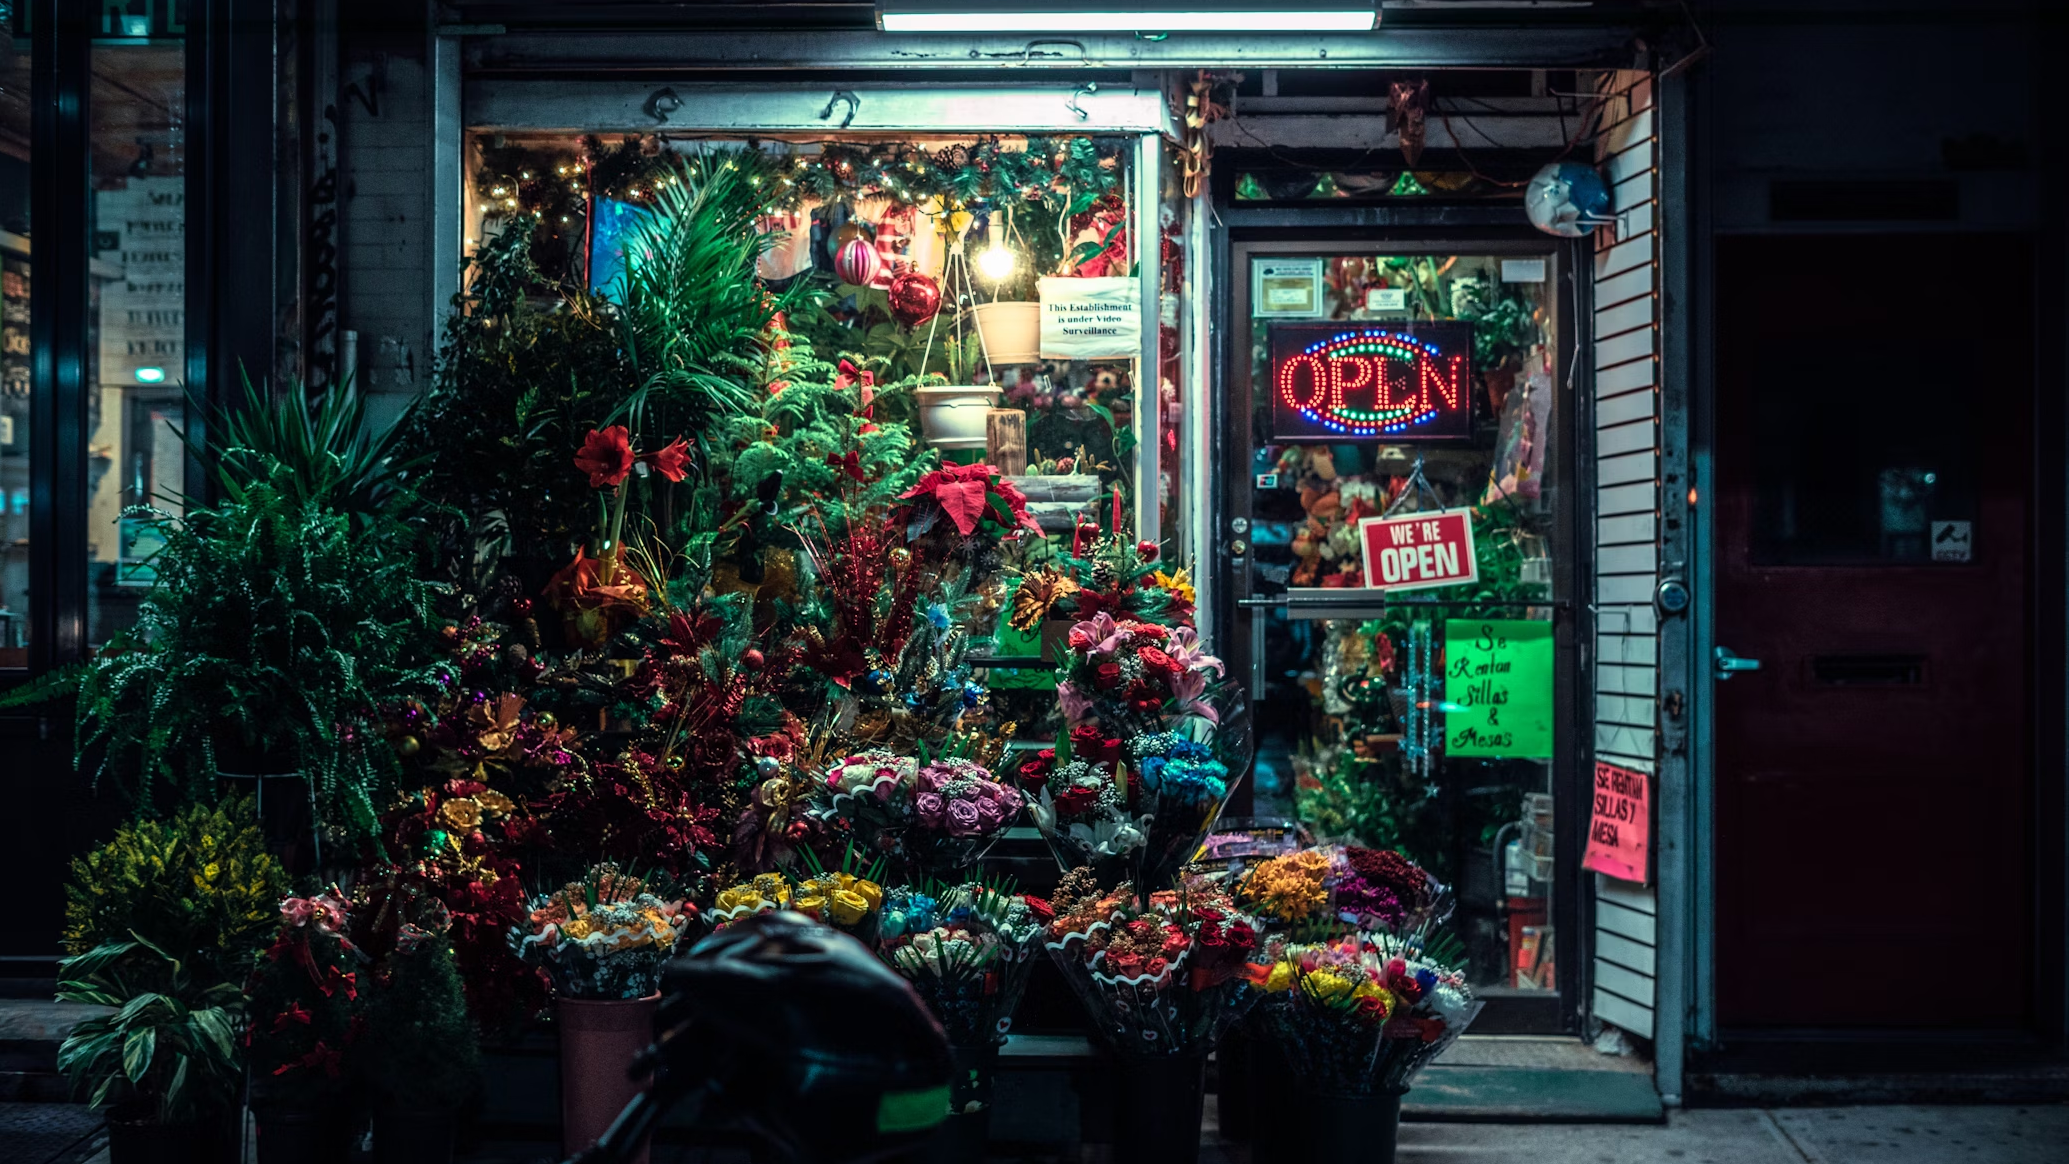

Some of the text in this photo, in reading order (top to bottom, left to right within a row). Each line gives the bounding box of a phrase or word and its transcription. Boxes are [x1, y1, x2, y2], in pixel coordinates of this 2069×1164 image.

[1049, 303, 1132, 312] This Establishment
[1058, 315, 1122, 323] is under Video
[1063, 327, 1117, 335] Surveillance
[1280, 354, 1463, 411] OPEN
[1390, 521, 1441, 545] WE'RE
[1381, 541, 1459, 583] OPEN
[1475, 624, 1507, 651] Se
[1448, 653, 1511, 679] Rentan
[1457, 679, 1508, 707] Sillas
[1487, 707, 1499, 726] &
[1452, 727, 1512, 749] Mesas
[1596, 767, 1609, 790] SE
[1594, 793, 1628, 821] SILLAS
[1592, 819, 1619, 848] MESA
